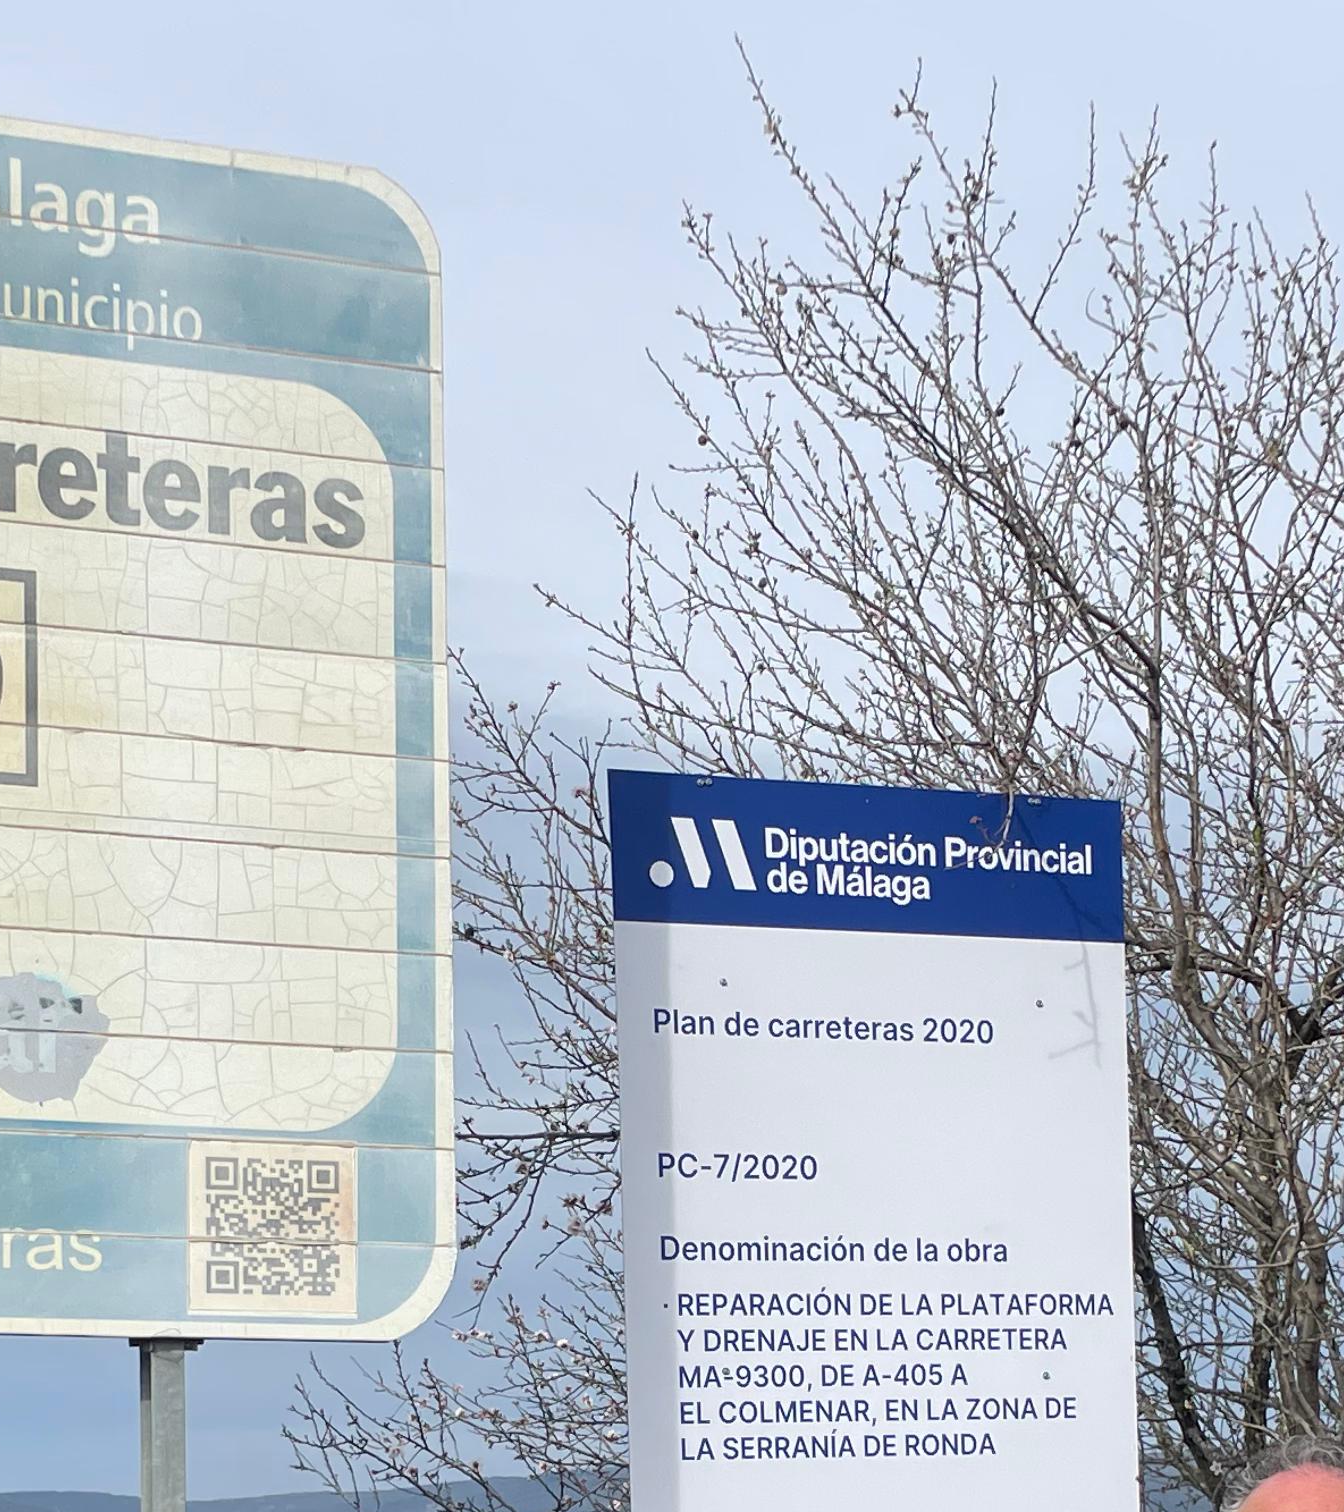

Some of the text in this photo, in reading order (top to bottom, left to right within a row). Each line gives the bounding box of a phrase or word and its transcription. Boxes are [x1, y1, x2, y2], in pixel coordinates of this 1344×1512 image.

[763, 828, 1092, 875] Diputación Provincial
[766, 864, 931, 905] de Málaga
[653, 1009, 994, 1044] Plan de carreteras 2020
[657, 1153, 818, 1182] PC-7/2020
[660, 1235, 1008, 1263] Denominación de la obra
[677, 1287, 1114, 1316] REPARACIÓN DE LA PLATAFORMA
[677, 1328, 1067, 1352] Y DRENAJE EN LA CARRETERA
[822, 1365, 854, 1387] DE
[863, 1365, 944, 1387] A-405
[951, 1364, 968, 1386] A
[680, 1397, 1077, 1426] EL COLMENAR, EN LA ZONA DE
[681, 1429, 996, 1461] LA SERRANÍA DE RONDA
